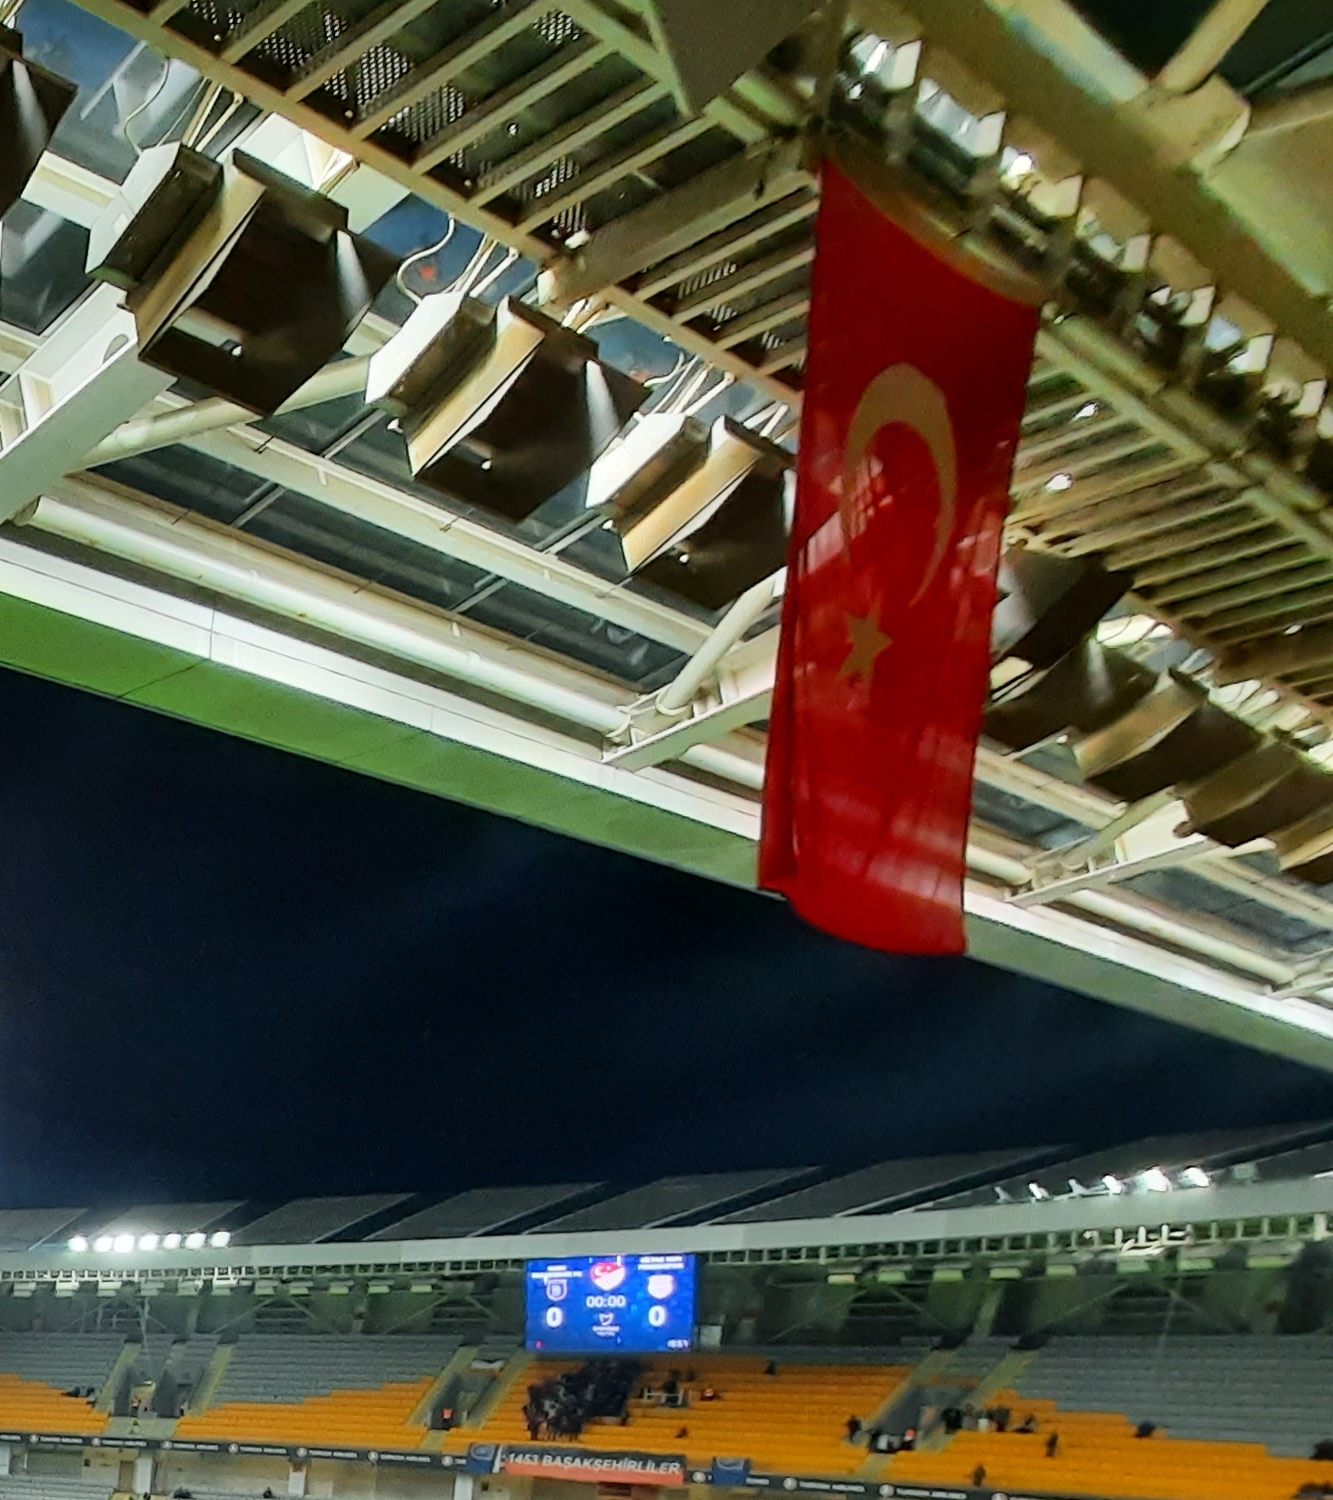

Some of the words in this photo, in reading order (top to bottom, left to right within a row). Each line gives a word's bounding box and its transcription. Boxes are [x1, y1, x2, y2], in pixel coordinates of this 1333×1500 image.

[586, 1295, 626, 1308] 00:00
[546, 1306, 563, 1328] 0
[648, 1305, 666, 1327] 0
[508, 1452, 539, 1465] 1453
